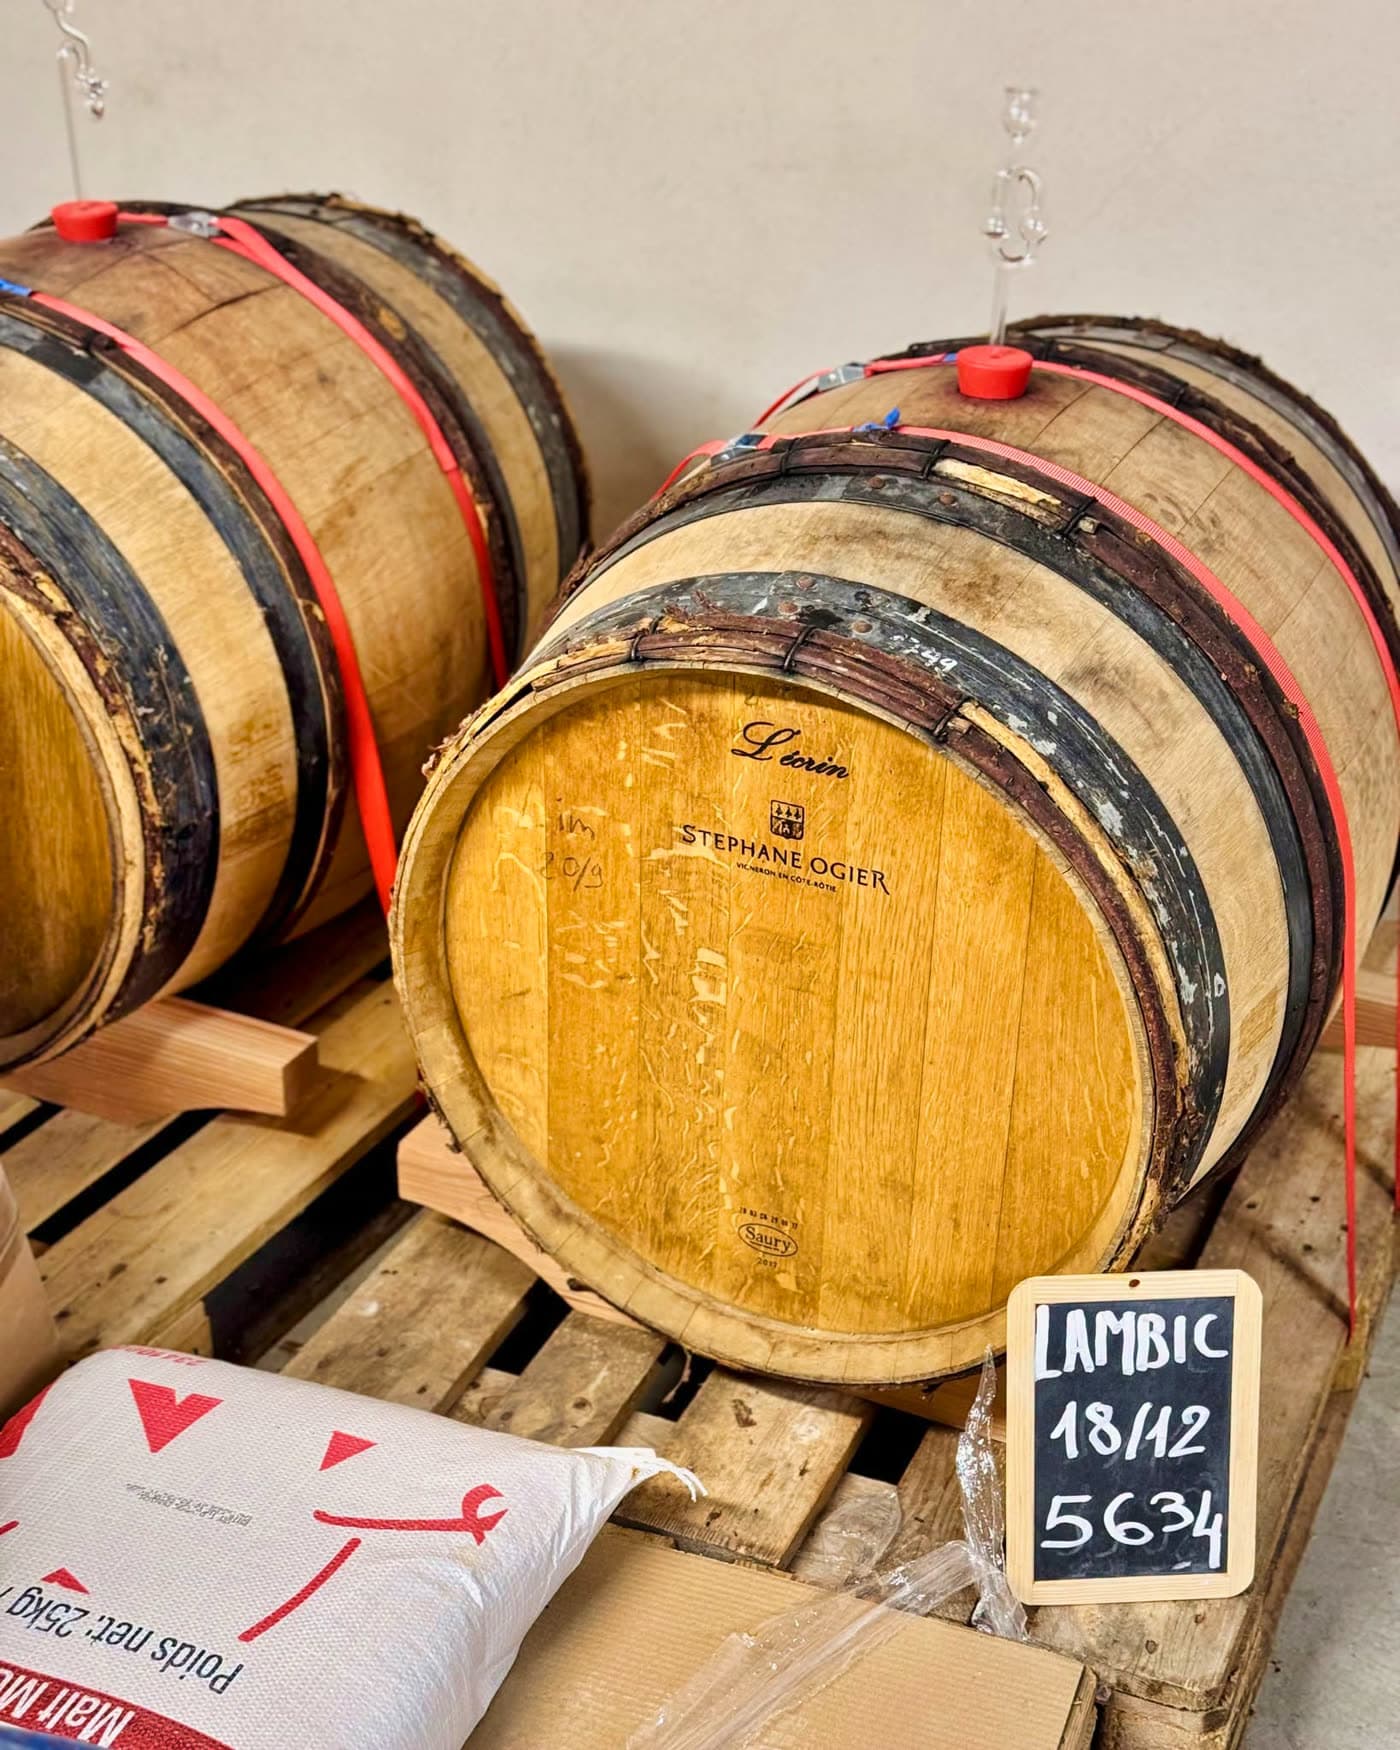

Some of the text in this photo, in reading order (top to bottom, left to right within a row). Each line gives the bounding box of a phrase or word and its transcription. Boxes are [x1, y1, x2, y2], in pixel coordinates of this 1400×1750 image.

[682, 824, 890, 896] STEPHANE OGIER
[745, 1225, 801, 1254] Saury
[1035, 1304, 1229, 1381] LAMBIC
[1050, 1401, 1211, 1461] 18/12
[1040, 1489, 1224, 1569] 5634
[6, 1586, 90, 1638] 25kg
[150, 1636, 244, 1695] Poids
[37, 1686, 136, 1749] Malt
